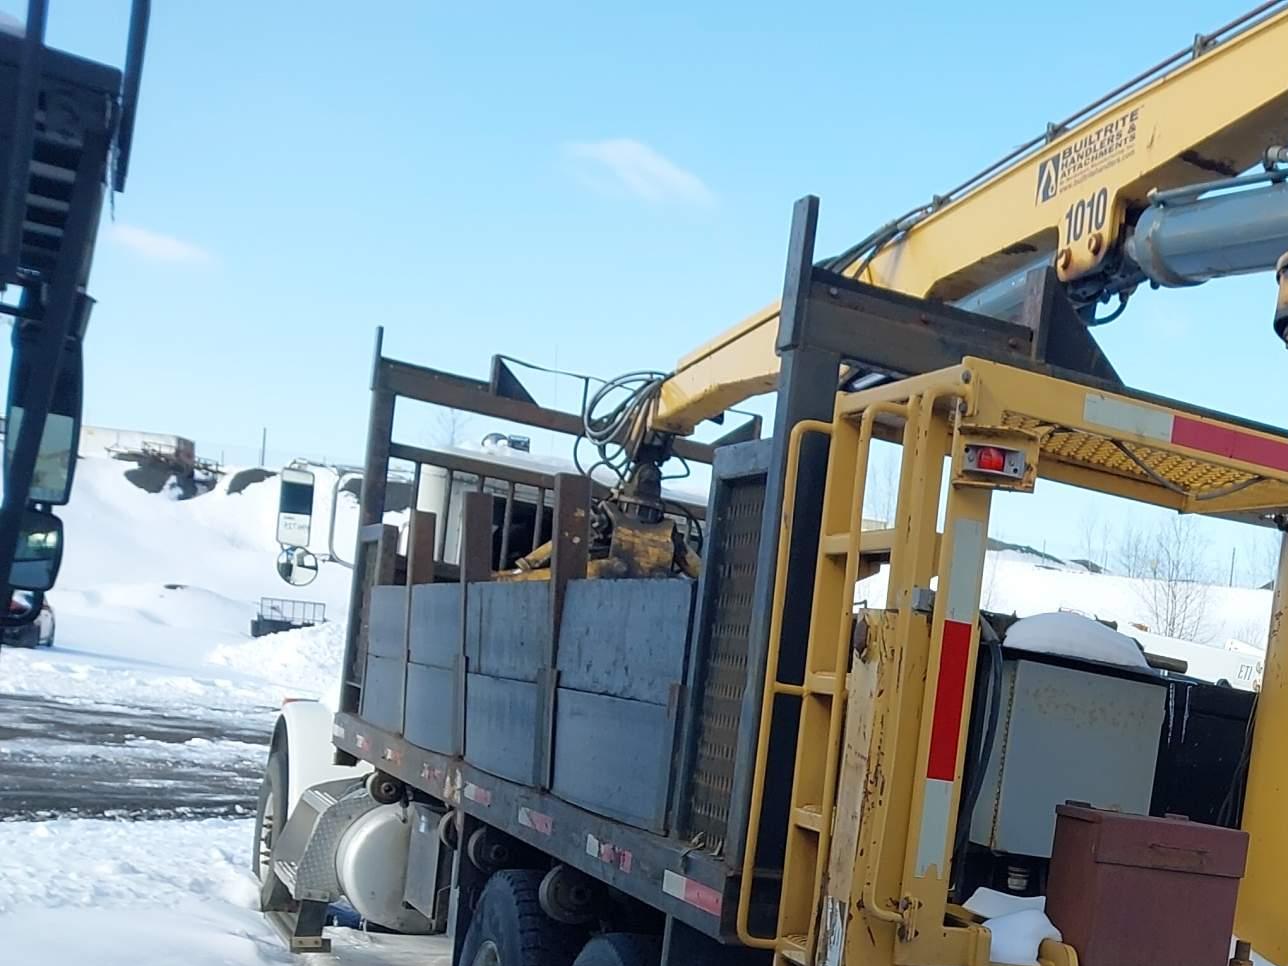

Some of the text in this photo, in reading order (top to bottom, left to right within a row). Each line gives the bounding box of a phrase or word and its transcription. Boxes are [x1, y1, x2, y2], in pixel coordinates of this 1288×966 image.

[1060, 133, 1137, 178] ATTACHMENTS
[1061, 133, 1123, 169] HANDLERS
[1127, 123, 1137, 133] &
[1062, 108, 1139, 159] BUILTRITE
[1065, 187, 1108, 245] 1010
[1237, 664, 1253, 681] ETI
